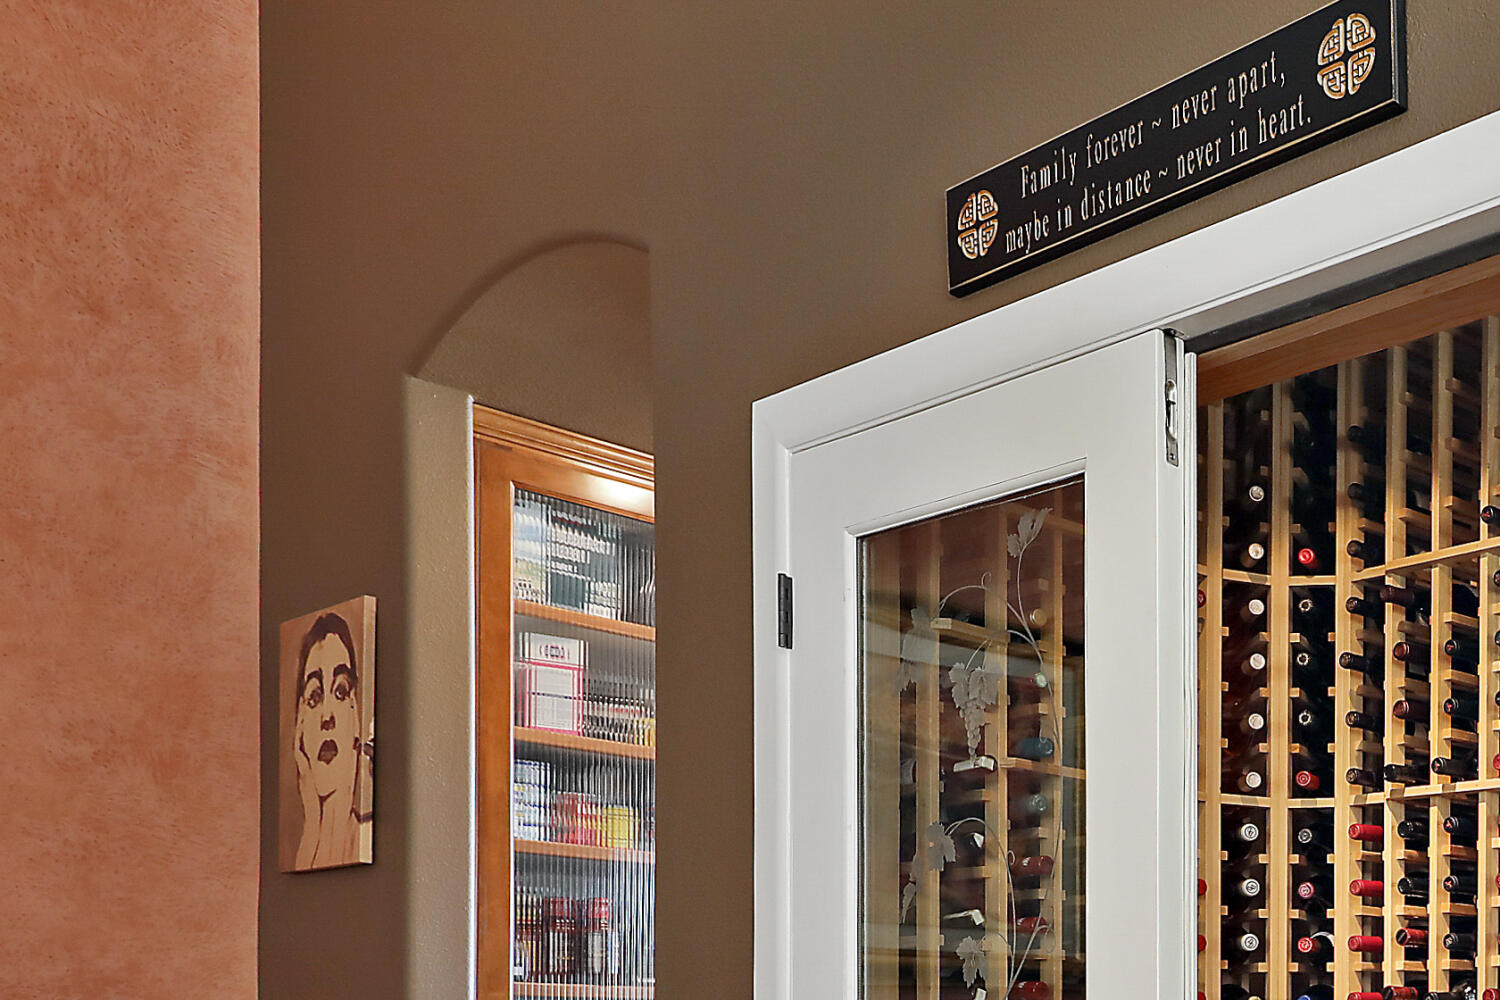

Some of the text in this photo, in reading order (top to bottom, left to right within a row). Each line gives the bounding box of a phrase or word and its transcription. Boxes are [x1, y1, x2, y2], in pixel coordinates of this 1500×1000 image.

[1005, 209, 1049, 254] maybe
[1057, 197, 1073, 232] in
[1080, 169, 1151, 221] distance
[1176, 137, 1222, 180] never
[1229, 119, 1249, 157] in
[1257, 93, 1311, 145] heart.
[1020, 145, 1077, 199] Family
[1086, 120, 1144, 169] forever
[1171, 85, 1217, 130] never
[1227, 50, 1285, 110] apart,
